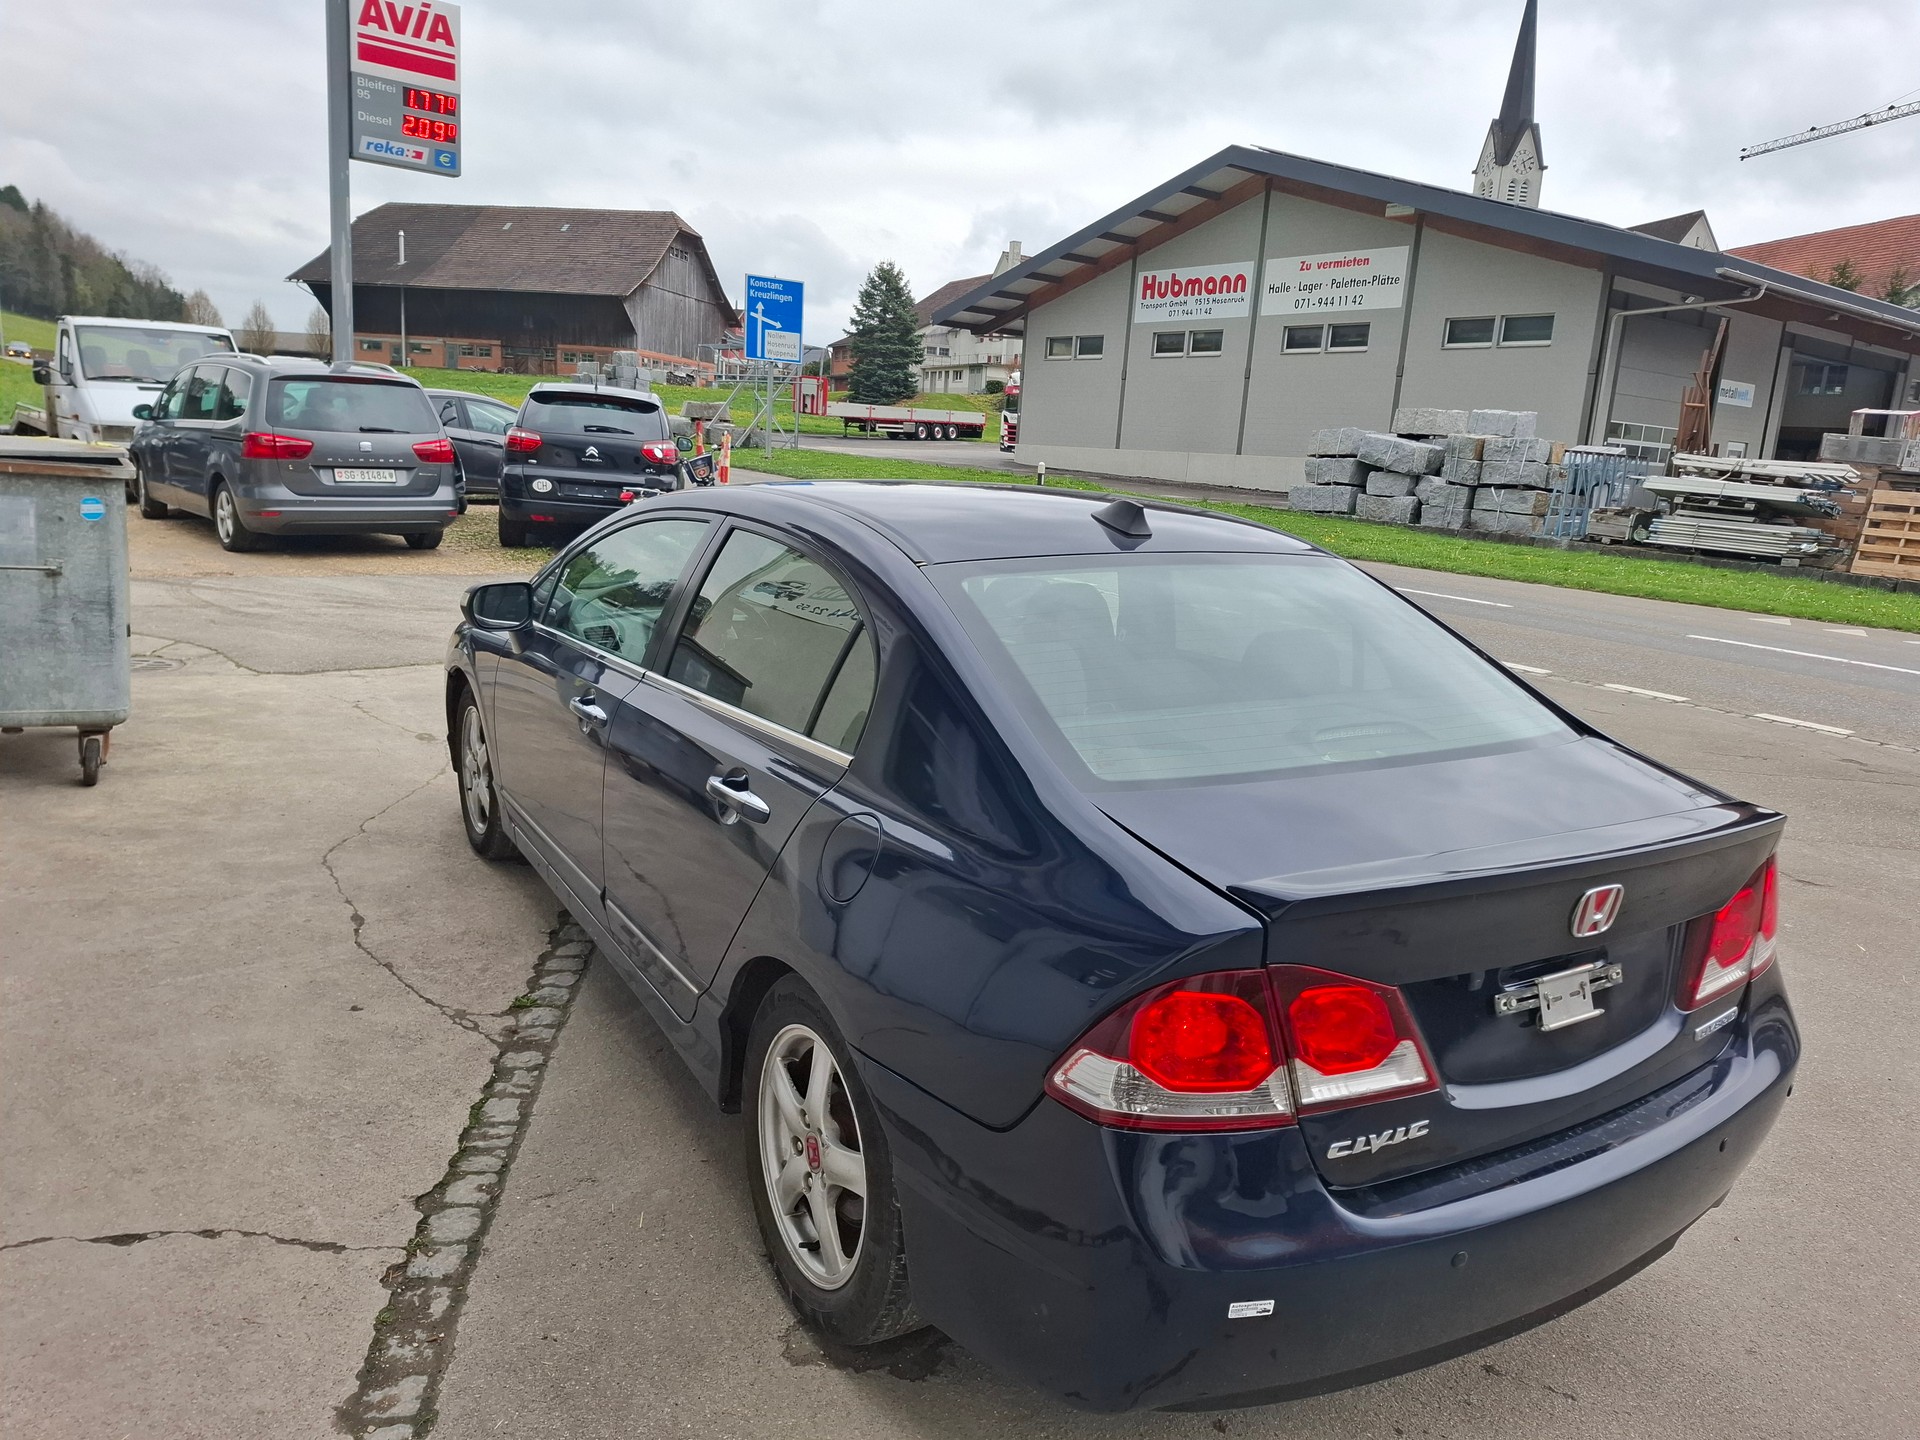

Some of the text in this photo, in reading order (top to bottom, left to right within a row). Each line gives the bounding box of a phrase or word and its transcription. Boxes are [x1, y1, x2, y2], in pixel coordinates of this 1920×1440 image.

[357, 77, 396, 93] Bleifrei
[357, 89, 371, 100] 95
[358, 111, 392, 126] Diesel
[1300, 256, 1370, 271] Zu vermieten
[750, 278, 783, 290] Konstanz
[1142, 273, 1247, 300] Hubmann
[1269, 274, 1400, 294] Halle Lager Paletten-Plätze
[750, 289, 793, 303] Kreuzlingen
[1338, 295, 1348, 306] 11
[1351, 294, 1363, 305] 42
[1140, 302, 1168, 310] Transport
[1168, 300, 1187, 308] GmbH
[1194, 298, 1210, 306] 9515
[767, 332, 786, 340] Nollen
[767, 349, 797, 358] Wuppenau
[536, 481, 548, 491] CH
[1327, 1120, 1430, 1159] CIVIC
